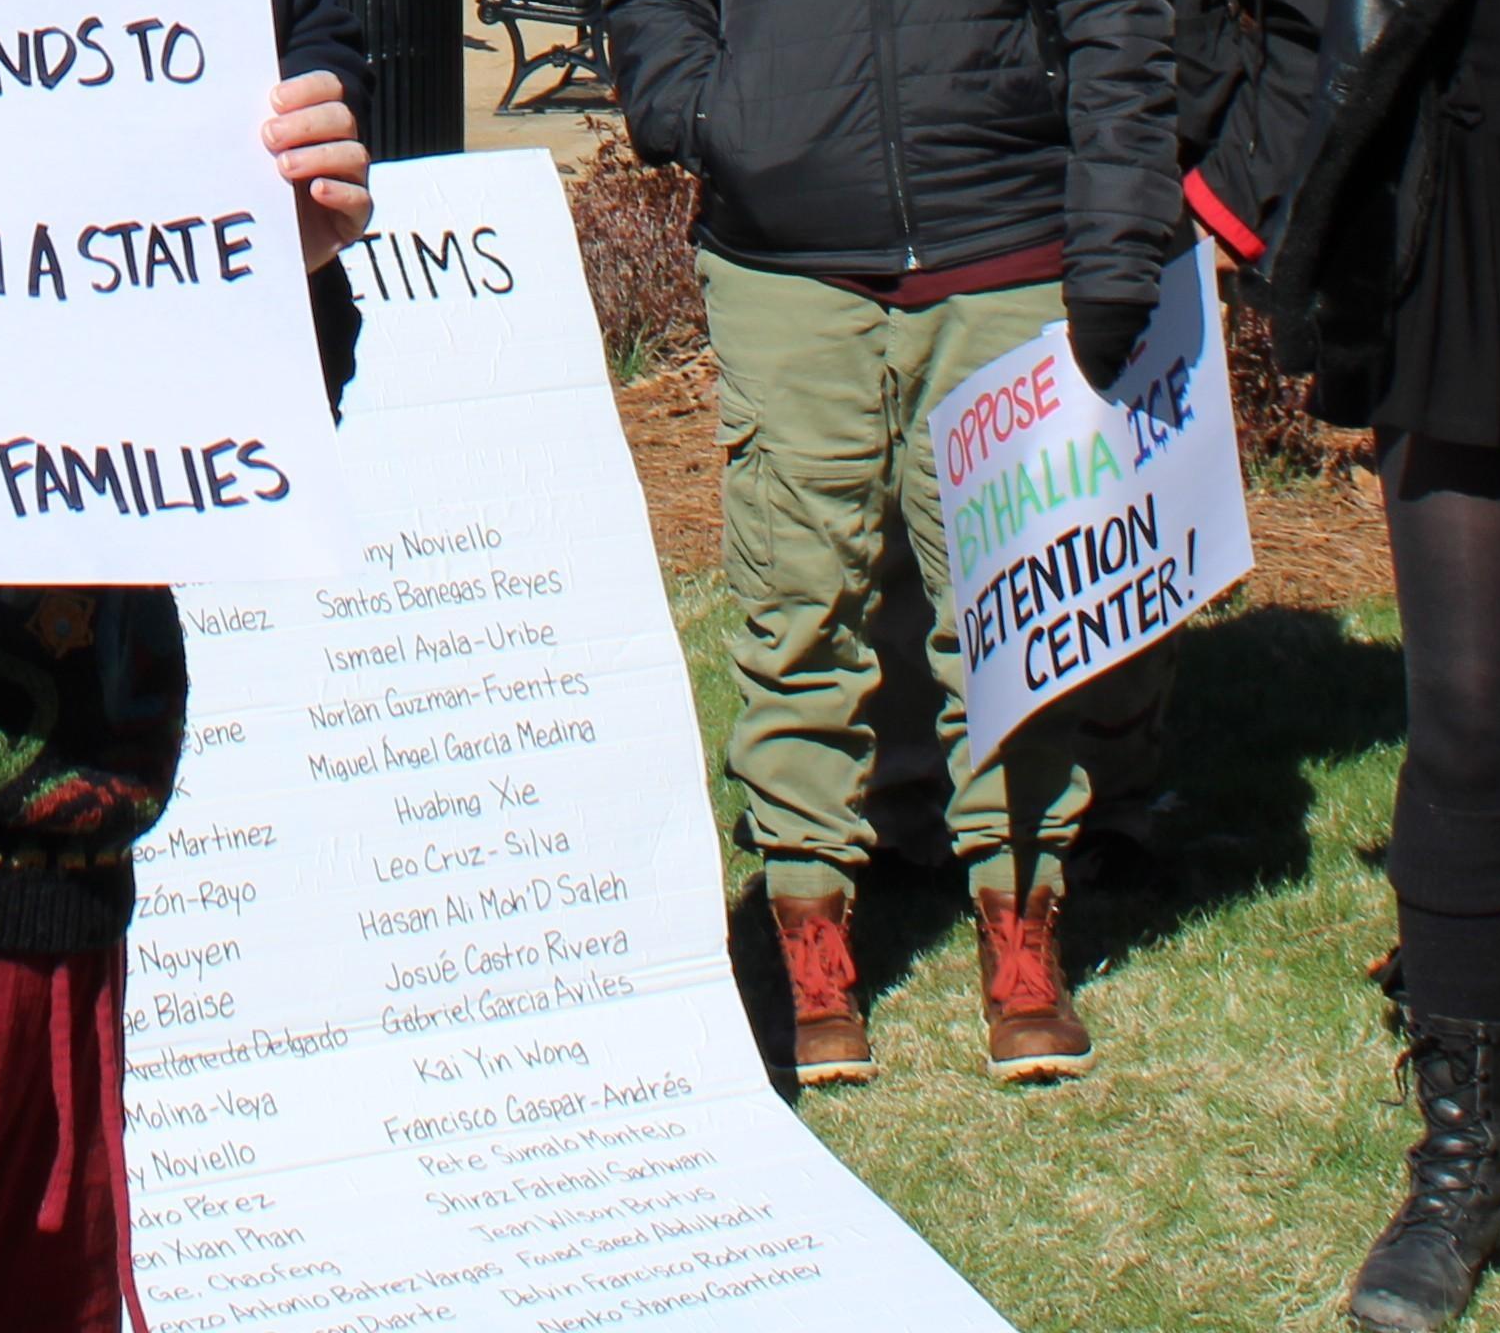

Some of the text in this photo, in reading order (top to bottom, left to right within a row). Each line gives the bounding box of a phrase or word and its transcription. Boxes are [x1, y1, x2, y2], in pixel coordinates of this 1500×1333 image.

[125, 19, 208, 87] TO
[28, 223, 65, 301] A
[76, 211, 256, 289] STATE
[348, 226, 514, 301] TIMS
[947, 355, 1061, 487] OPPOSE
[954, 356, 1193, 579] BYHALIA ICE
[400, 523, 502, 559] Noviello
[316, 569, 562, 619] Santos Banegas Reyes
[963, 492, 1158, 675] DETENTION
[187, 606, 275, 636] Valdez
[1024, 528, 1196, 692] CENTER!
[324, 621, 557, 672] Ismael Ayala-Uribe
[308, 668, 590, 730] Norlan Guzman-Fuentes
[308, 746, 378, 782] Miguel
[516, 718, 596, 749] Medina
[394, 775, 540, 824] Huabing Xie
[373, 856, 418, 883] Leo
[358, 905, 438, 941] Hasan
[446, 894, 474, 926] Ali
[557, 870, 628, 906] Saleh
[138, 939, 241, 981] Nguyen
[385, 929, 629, 992] Josué Castro Rivera
[153, 990, 236, 1027] Blaise
[382, 994, 476, 1035] Gabriel
[553, 969, 634, 1007] Aviles
[252, 1021, 349, 1059] Delgado
[412, 1039, 589, 1084] Kai Yin Wong
[124, 1088, 279, 1134] Molina-Veya
[383, 1072, 692, 1146] Francisco Gaspar-Andrés
[150, 1140, 256, 1181] Noviello
[418, 1151, 488, 1178] Pete
[183, 1193, 276, 1220] Pérez
[426, 1187, 516, 1217] Shiraz
[469, 1185, 716, 1244] Jean Wilson Brutus
[162, 1238, 236, 1265] Xuan
[234, 1226, 305, 1251] Phan
[228, 1293, 330, 1323] Antonio
[416, 1260, 503, 1286] Vargas
[581, 1259, 694, 1293] Francisco
